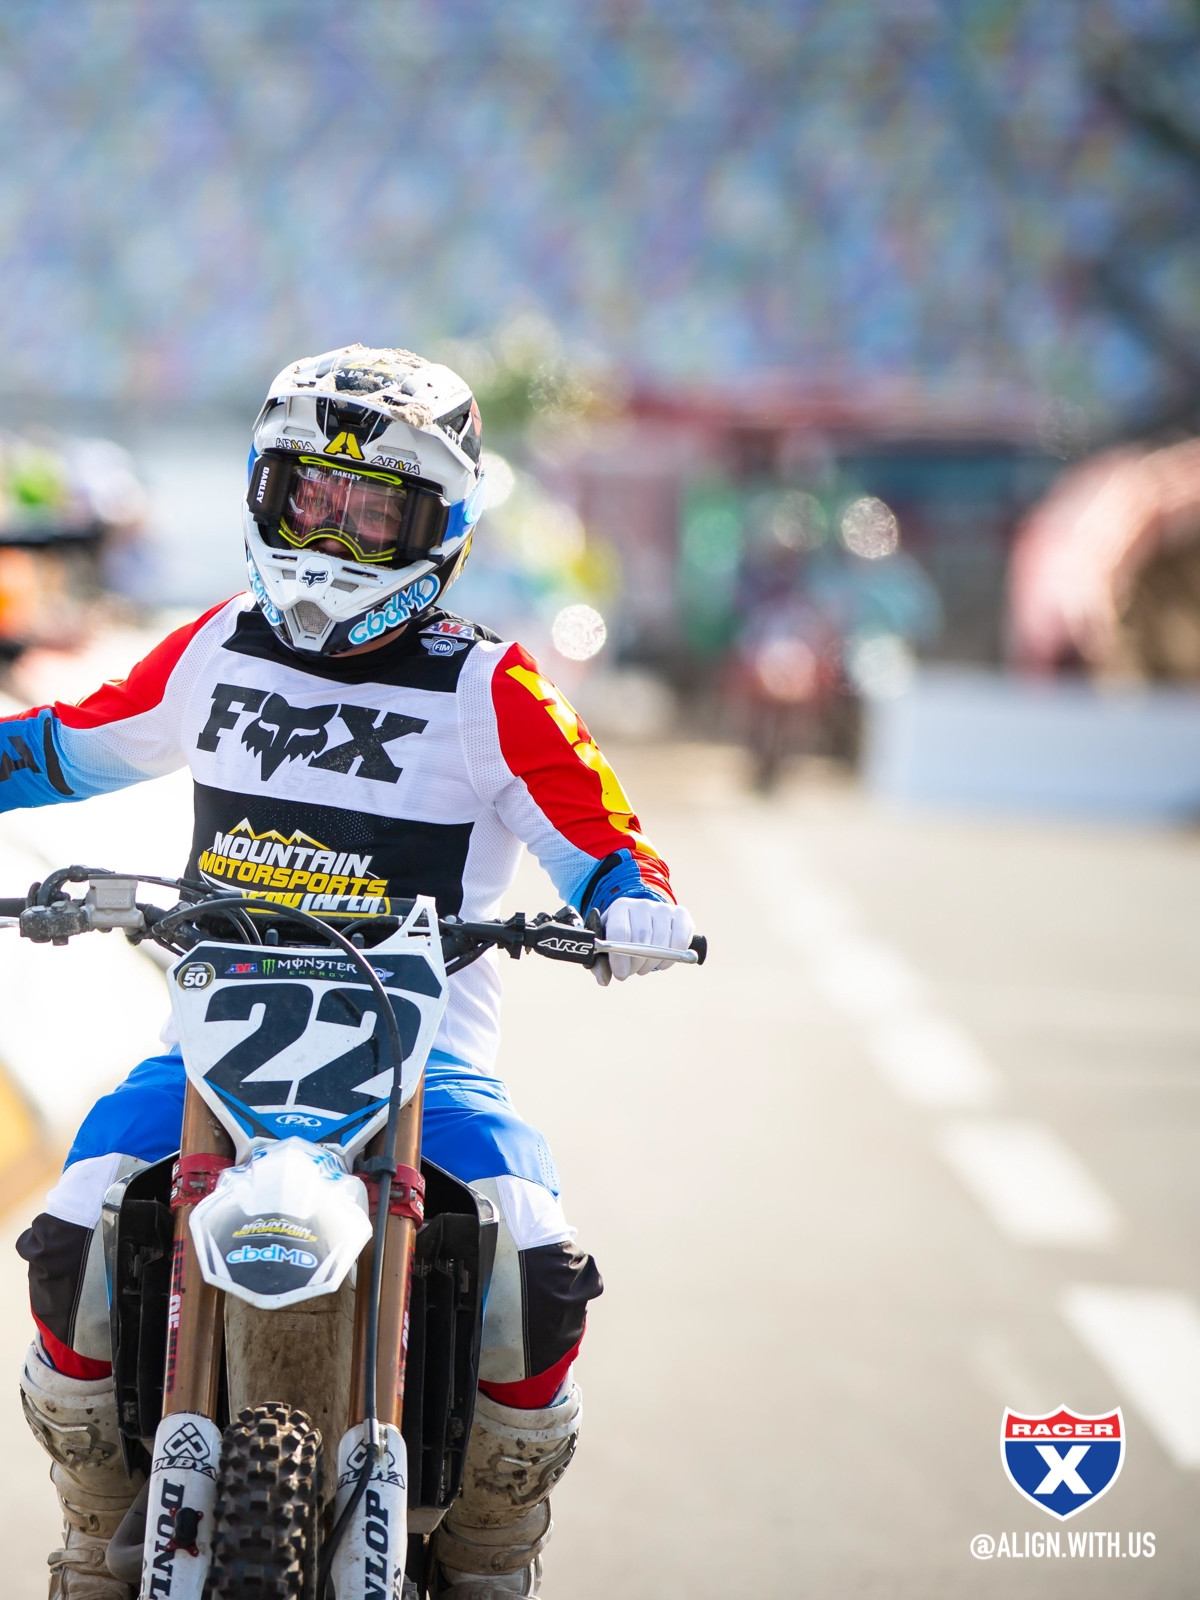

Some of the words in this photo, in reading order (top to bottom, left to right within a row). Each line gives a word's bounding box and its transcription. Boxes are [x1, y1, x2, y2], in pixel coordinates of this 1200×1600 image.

[275, 437, 316, 452] ARMA
[370, 455, 421, 475] ARMA
[332, 469, 362, 481] OAKLEY
[256, 466, 270, 503] OAKLEY
[349, 573, 440, 645] cbdMD
[419, 621, 474, 640] AMA
[434, 643, 451, 652] FIM
[212, 831, 373, 878] MOUNTAIN
[199, 849, 389, 898] MOTORSPORTS
[537, 937, 593, 955] ARC
[225, 963, 258, 974] AMA
[277, 957, 358, 974] MONSTER
[289, 970, 345, 979] ENERGY
[183, 972, 208, 987] 50
[203, 982, 422, 1121] 22
[240, 1221, 312, 1235] MOUNTAIN
[226, 1244, 318, 1268] cbdMD
[152, 1456, 217, 1481] DUBYA
